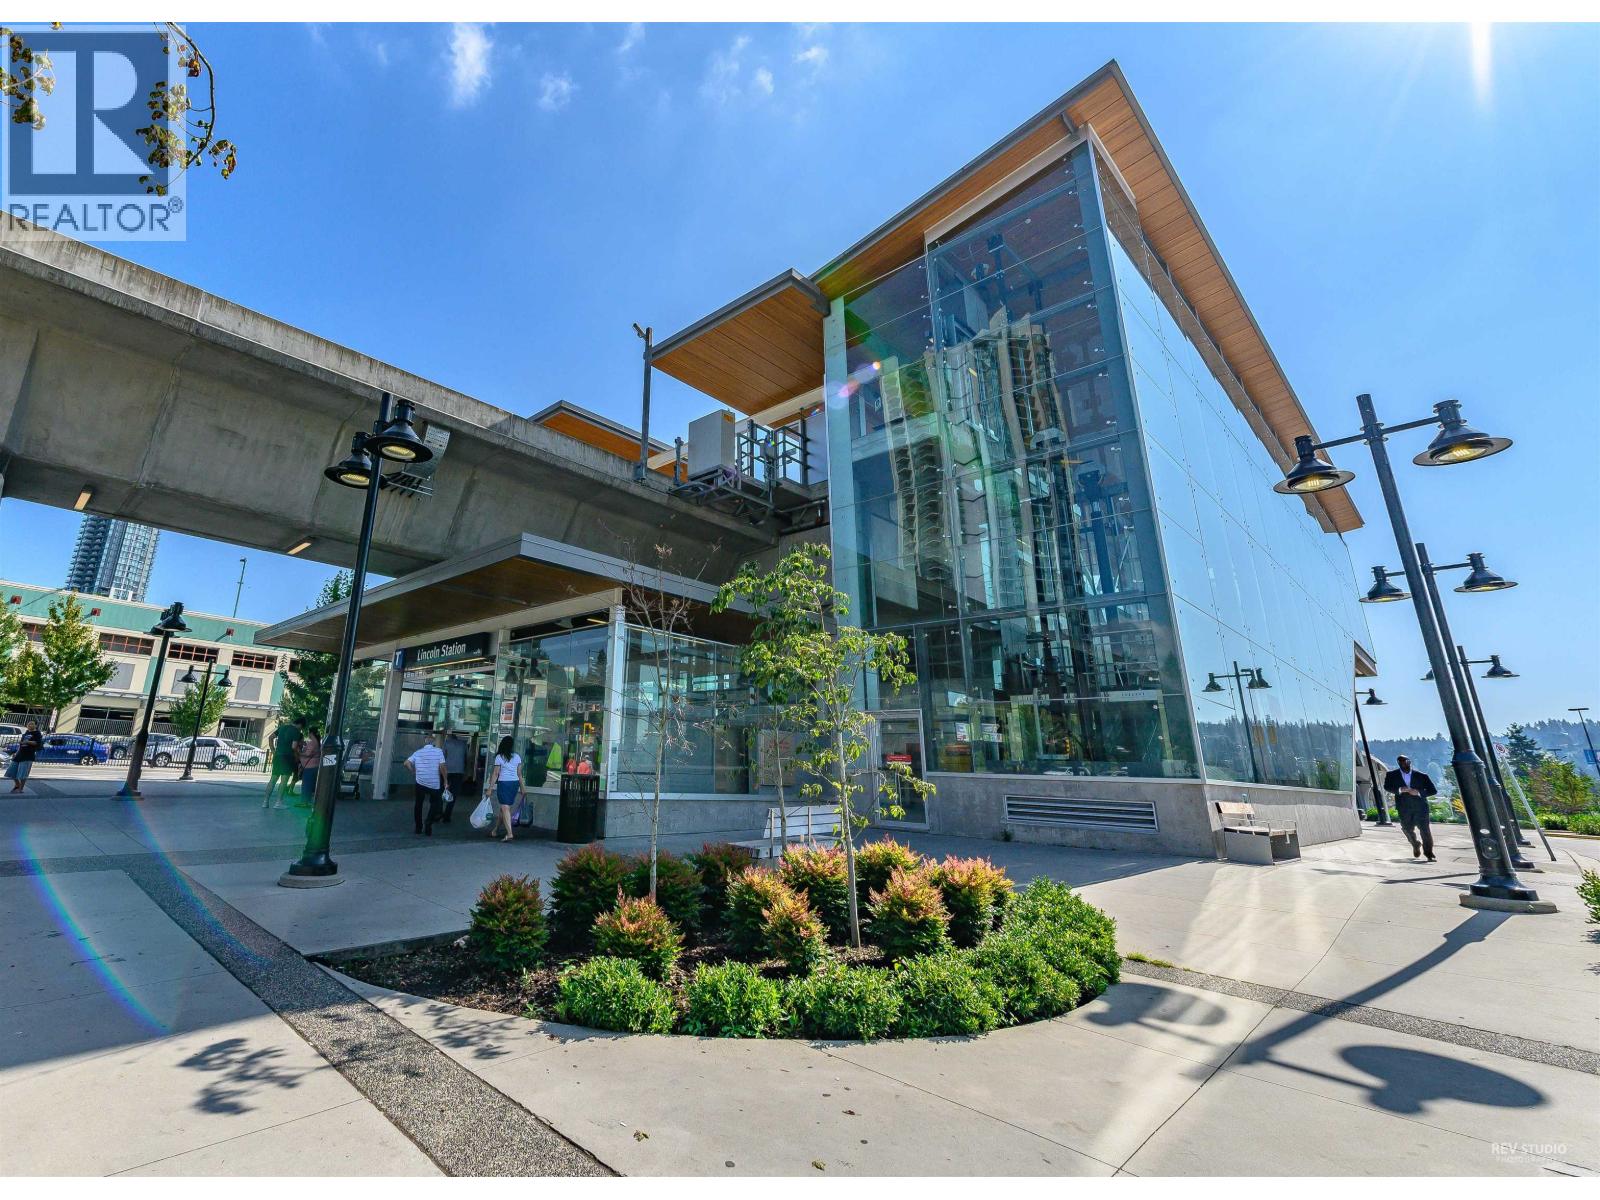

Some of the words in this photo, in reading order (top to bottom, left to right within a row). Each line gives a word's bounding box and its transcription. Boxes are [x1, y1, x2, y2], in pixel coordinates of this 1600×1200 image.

[395, 650, 402, 666] T
[417, 645, 440, 661] Lincoln
[441, 642, 466, 657] Station
